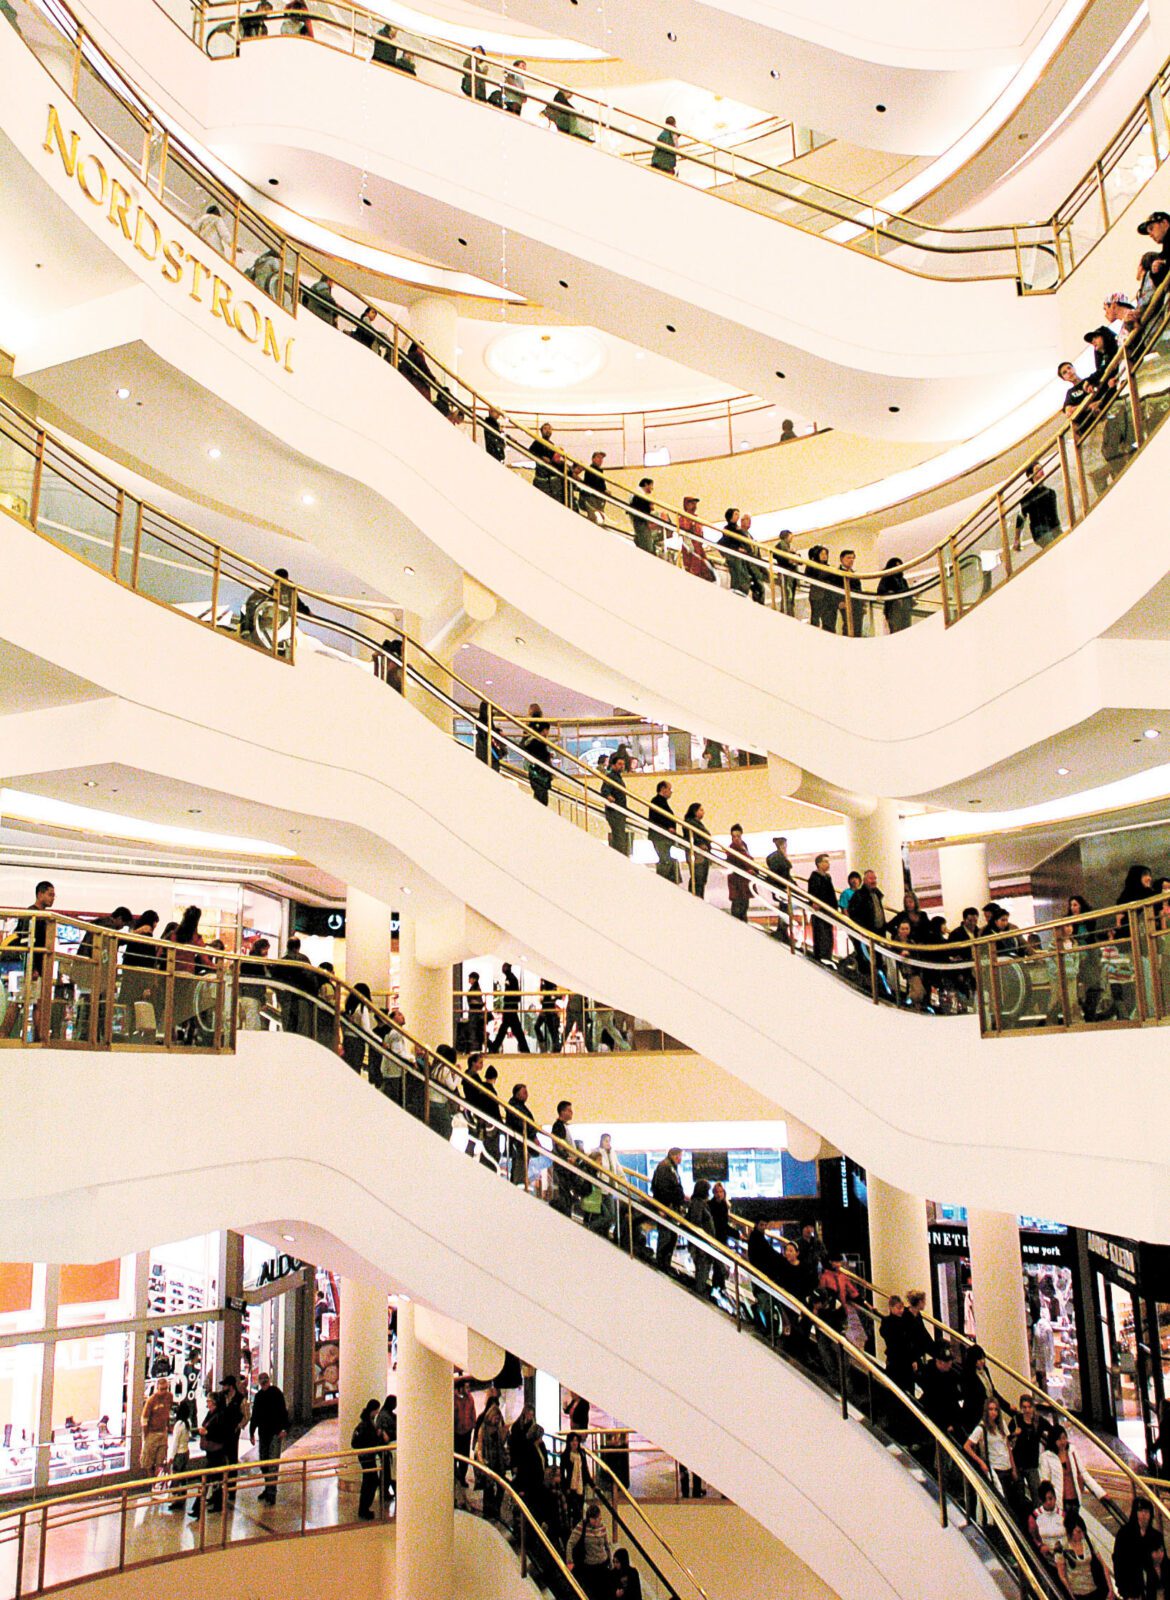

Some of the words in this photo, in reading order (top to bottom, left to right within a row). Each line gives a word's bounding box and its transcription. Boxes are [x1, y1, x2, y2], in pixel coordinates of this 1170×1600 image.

[42, 104, 296, 373] NORDSTROM
[1023, 1245, 1039, 1254] new
[1041, 1246, 1060, 1256] york
[256, 1253, 305, 1287] ALDO
